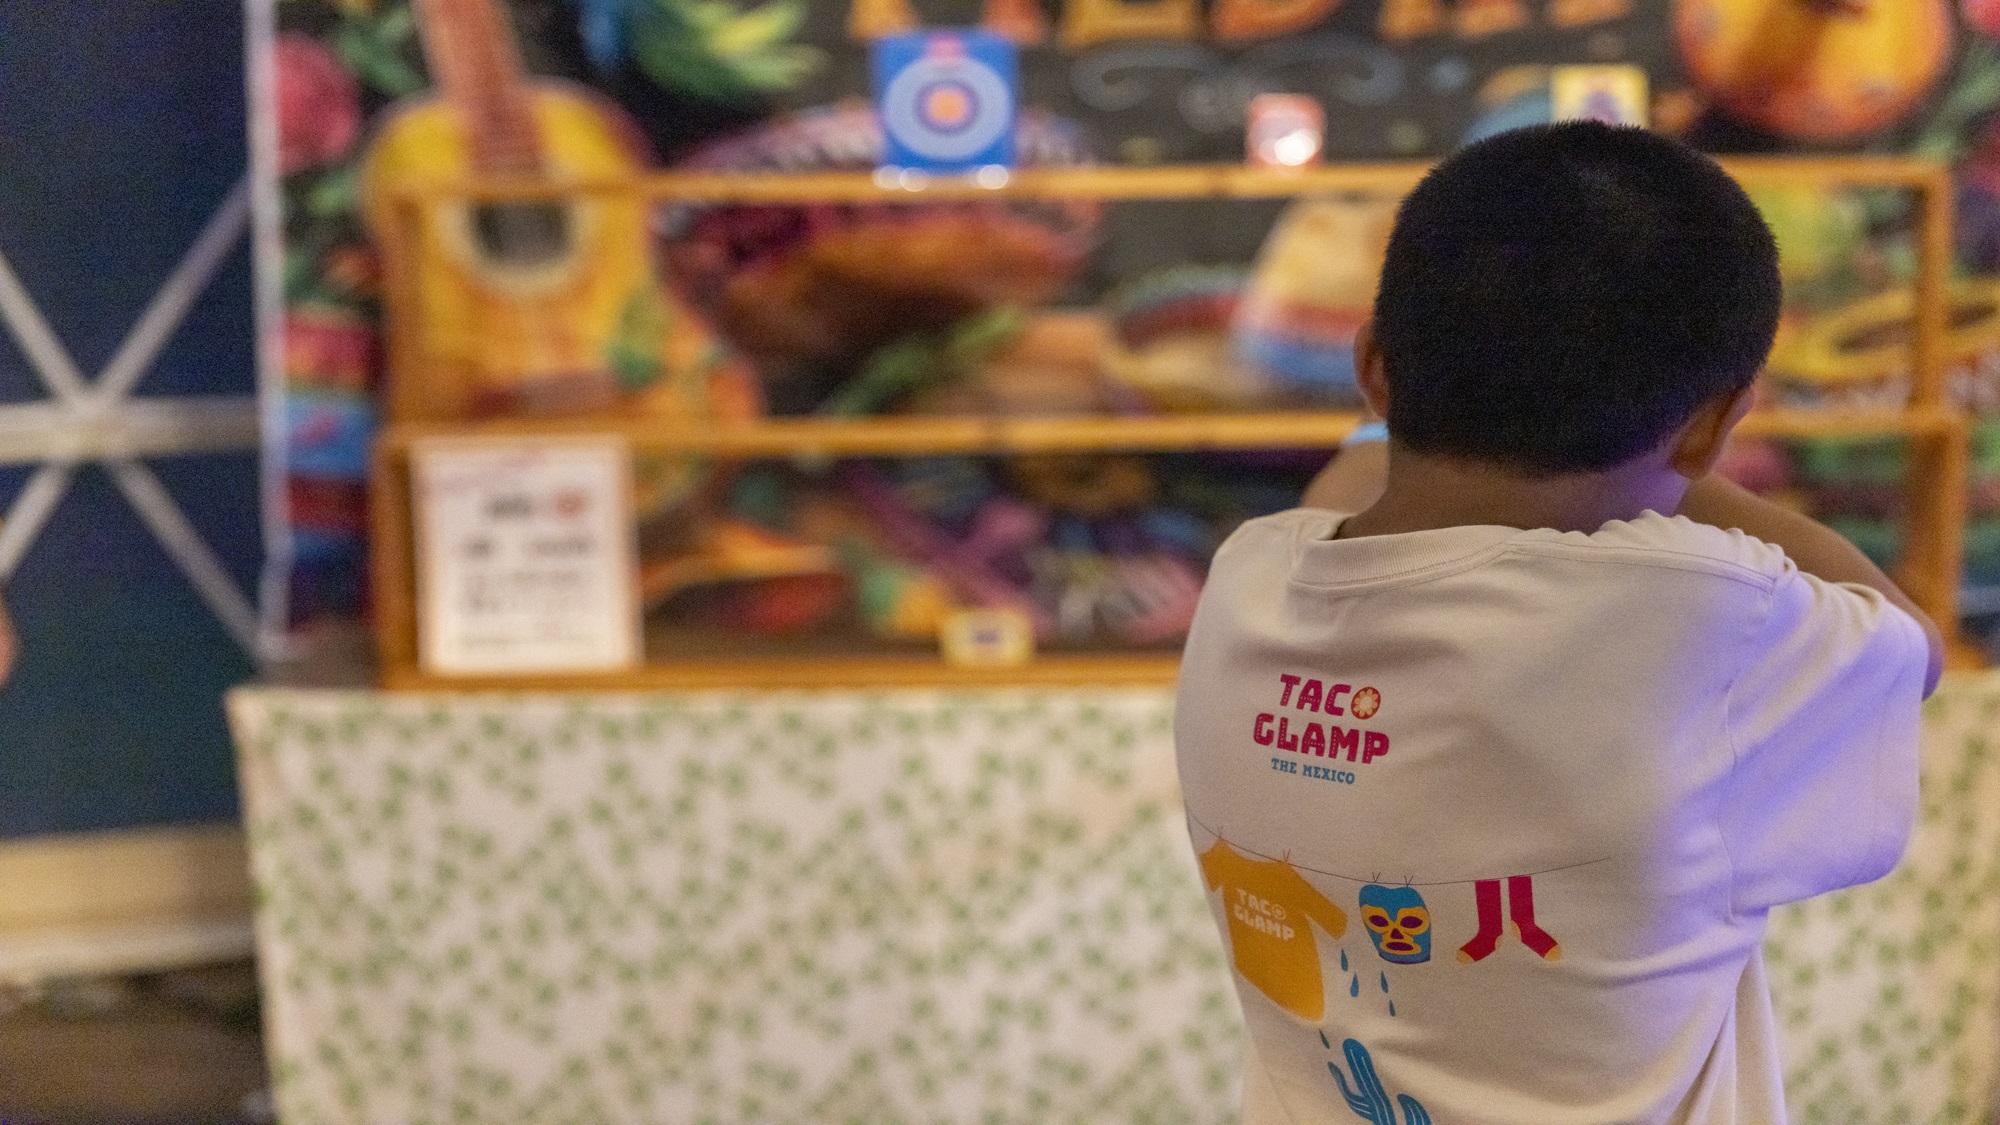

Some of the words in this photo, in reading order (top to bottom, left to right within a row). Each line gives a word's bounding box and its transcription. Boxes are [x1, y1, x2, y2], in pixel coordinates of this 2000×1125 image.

[1280, 673, 1381, 720] TACO
[1253, 712, 1390, 765] GLAMP
[1271, 757, 1298, 775] THE
[1302, 763, 1356, 785] MEXICO
[1233, 904, 1295, 941] GLAMP
[1237, 888, 1287, 921] TACO
